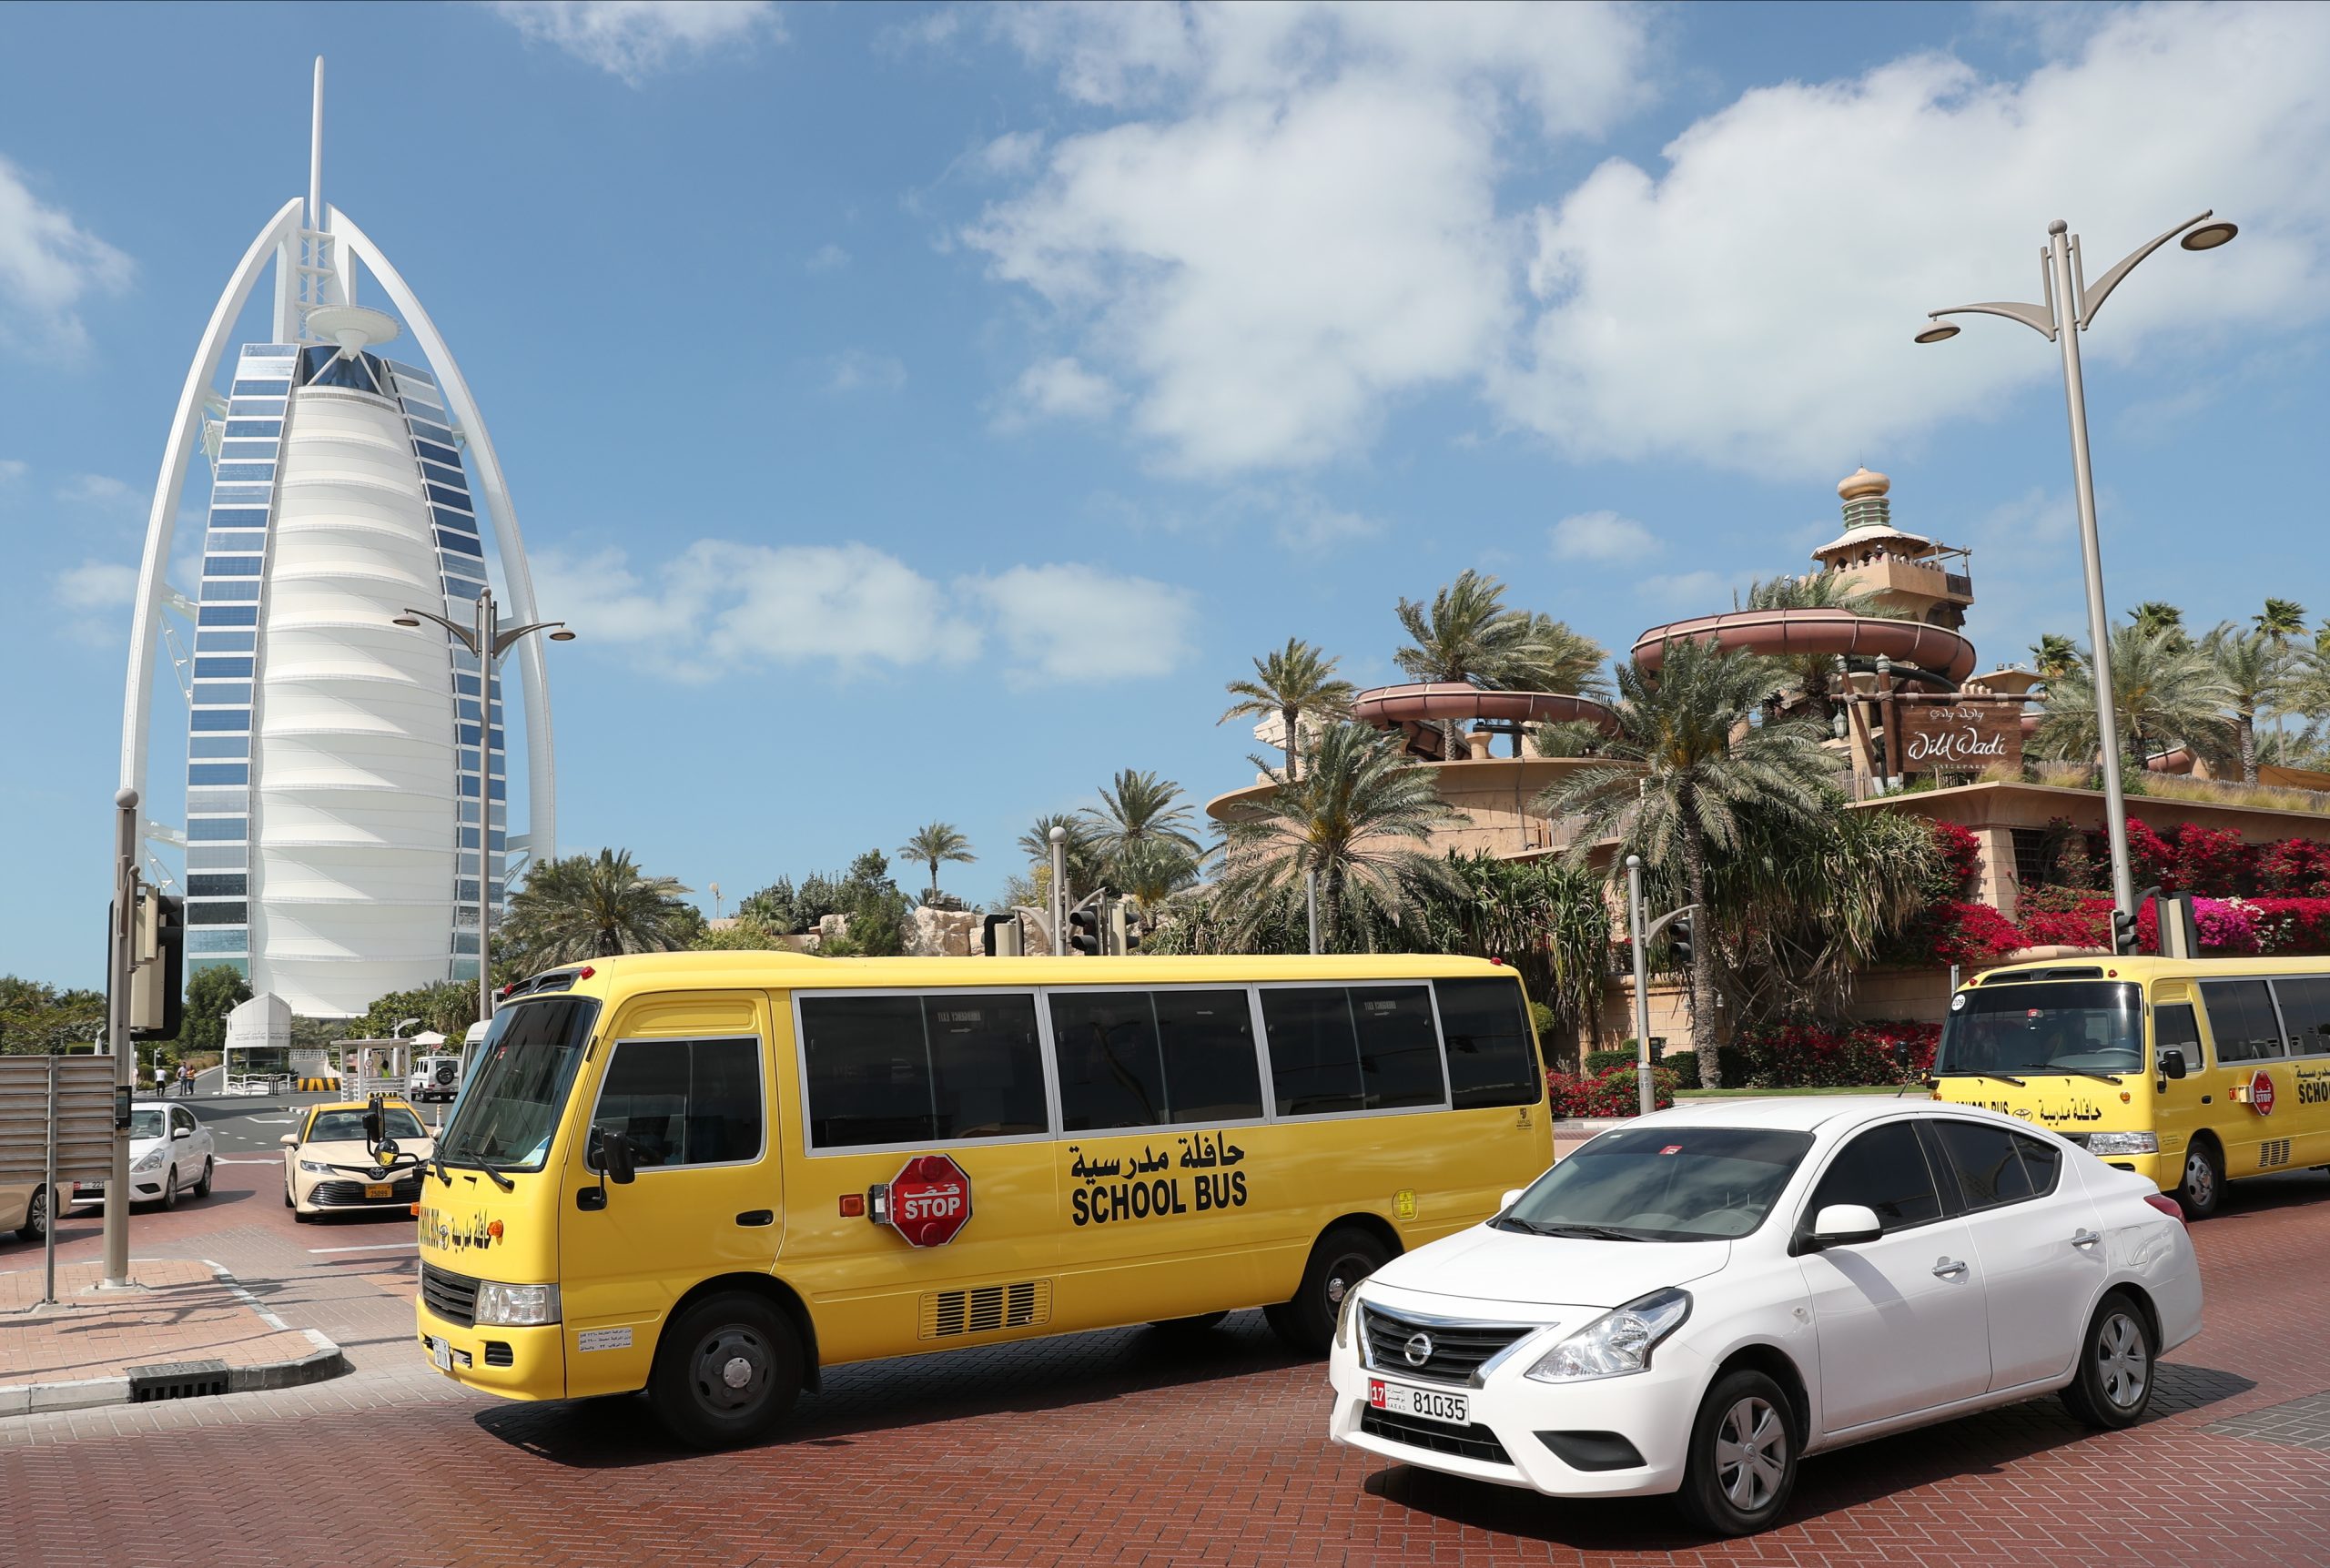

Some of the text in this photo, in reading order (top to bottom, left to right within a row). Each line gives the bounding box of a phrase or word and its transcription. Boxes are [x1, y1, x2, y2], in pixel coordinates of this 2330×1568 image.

[1908, 725, 2007, 761] Wild Wadi
[2255, 1093, 2272, 1103] STOP
[2298, 1081, 2330, 1104] SCHO
[2039, 1098, 2102, 1127] حافلة مدرسية
[1069, 1130, 1245, 1186] حافلة مدرسية
[904, 1183, 960, 1199] قف
[1072, 1170, 1248, 1226] SCHOOL BUS
[905, 1197, 960, 1219] STOP
[452, 1217, 471, 1254] مدرسية
[1372, 1386, 1384, 1401] 17
[1413, 1391, 1465, 1421] 81035
